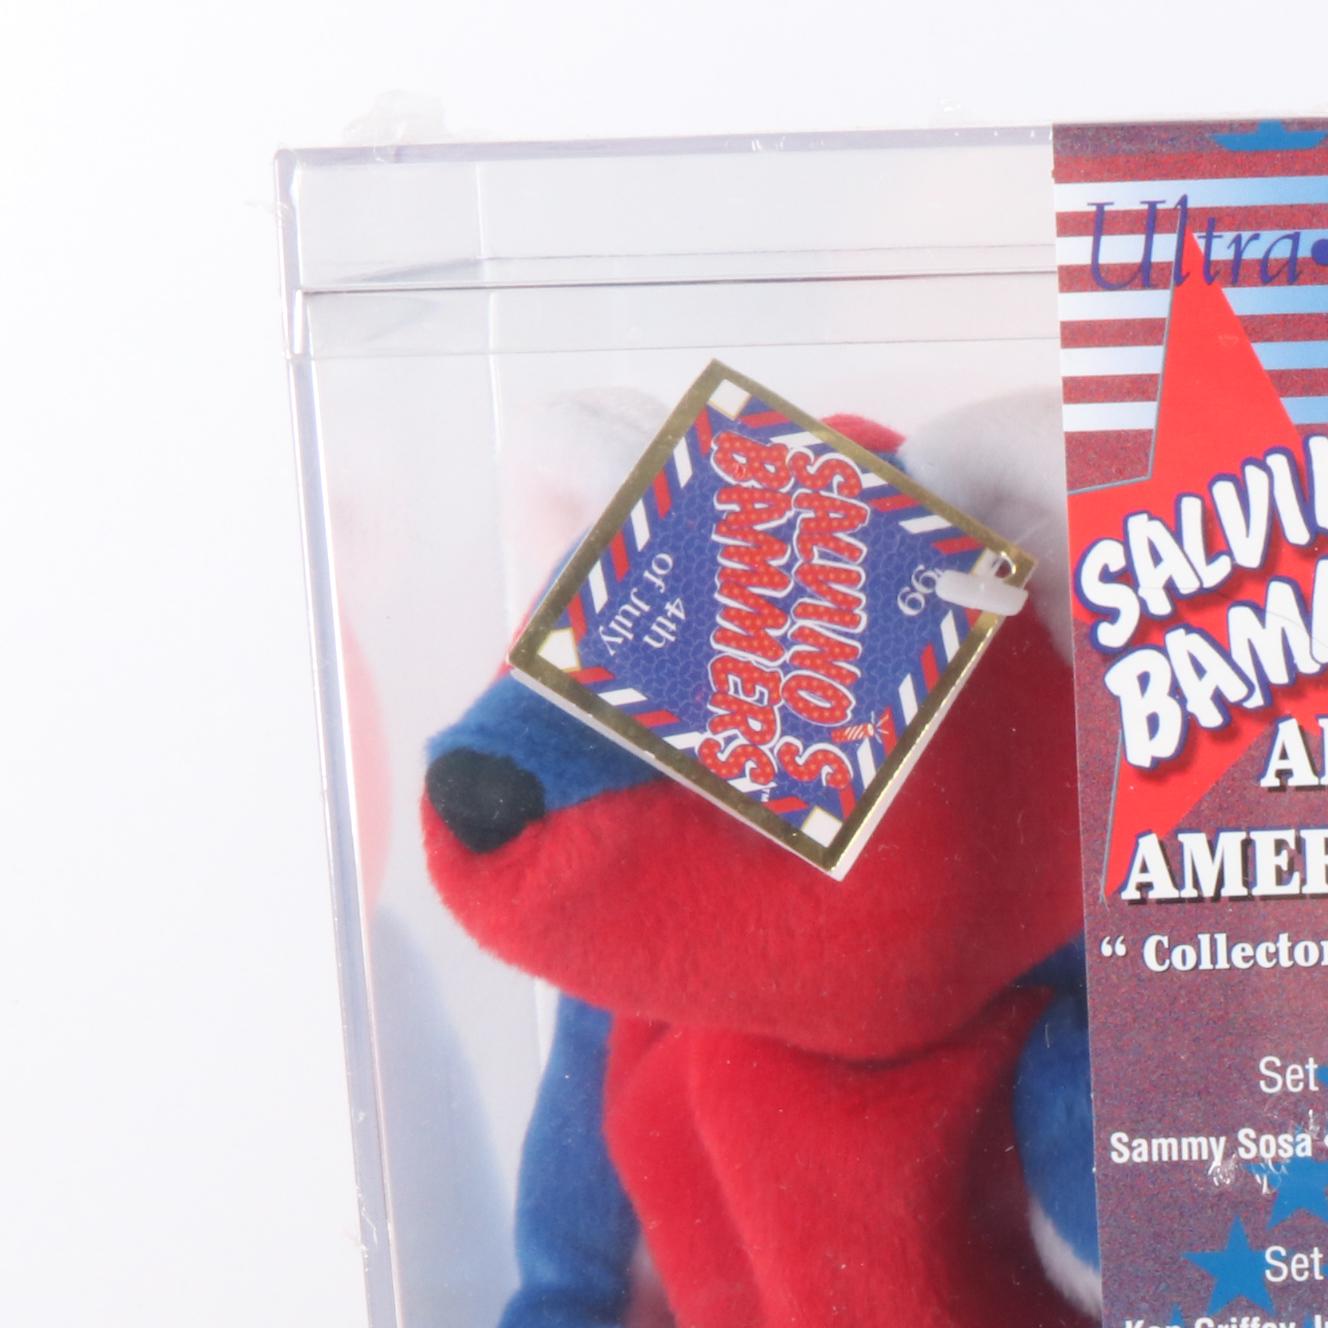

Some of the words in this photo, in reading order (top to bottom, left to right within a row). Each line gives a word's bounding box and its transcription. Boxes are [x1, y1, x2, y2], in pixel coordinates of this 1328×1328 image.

[643, 552, 674, 595] of
[598, 587, 652, 657] July
[643, 597, 687, 650] 4th
[697, 430, 795, 786] BAMMERS
[1258, 1055, 1319, 1095] Set
[1109, 1131, 1227, 1163] Sammy
[1236, 1129, 1314, 1160] Sosa
[1264, 1245, 1325, 1283] Set
